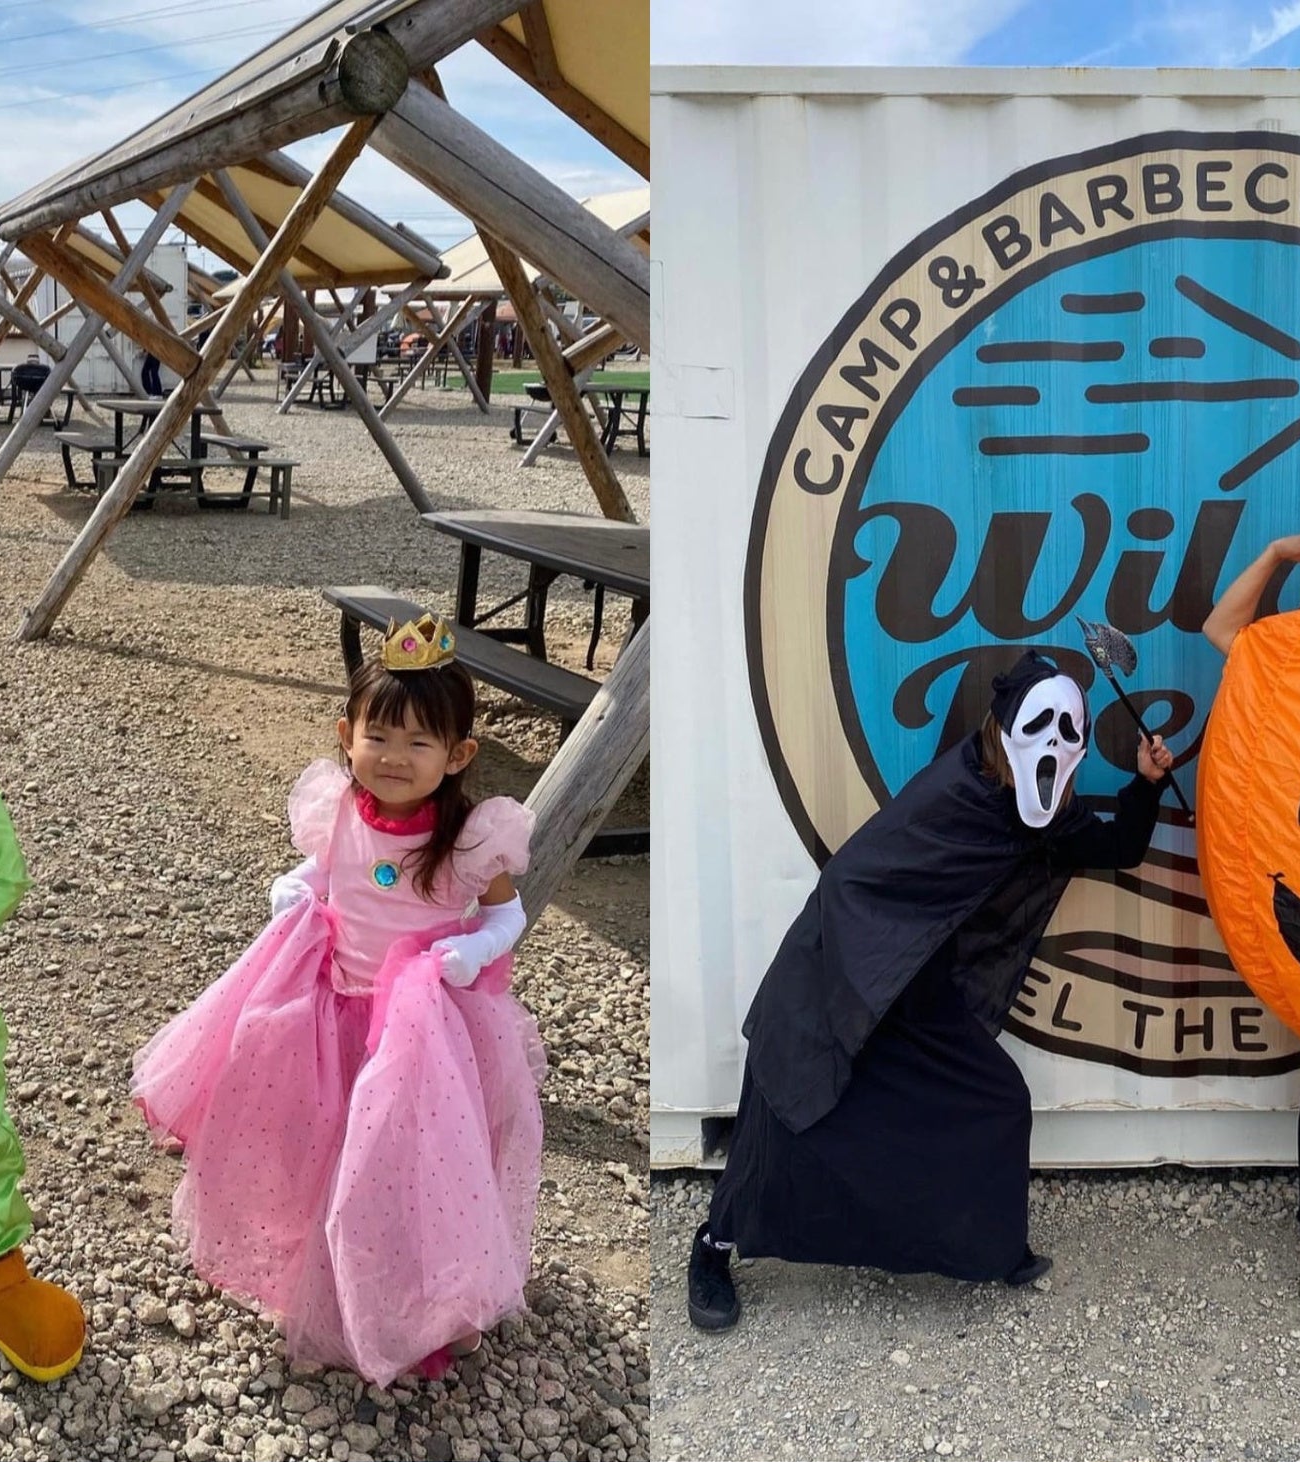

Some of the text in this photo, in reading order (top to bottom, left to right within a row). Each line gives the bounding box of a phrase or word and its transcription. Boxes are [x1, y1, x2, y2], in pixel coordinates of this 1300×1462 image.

[793, 297, 922, 495] CAMP
[927, 256, 986, 308] &
[1122, 1000, 1268, 1053] THE
